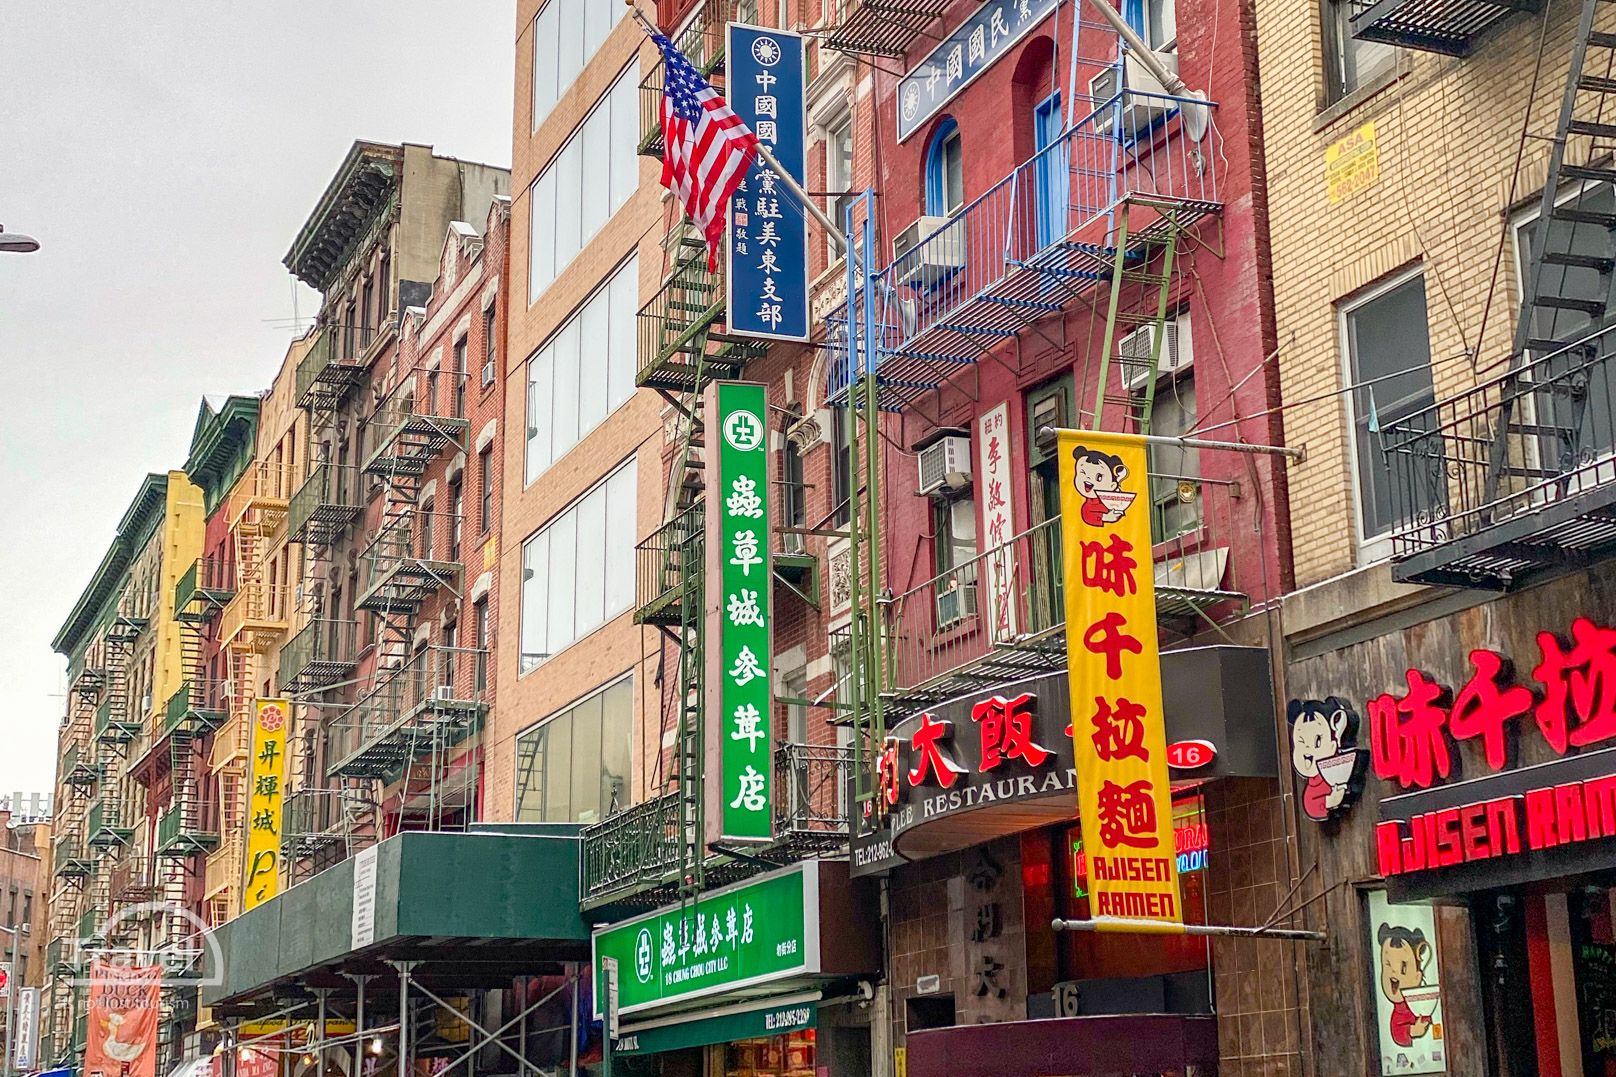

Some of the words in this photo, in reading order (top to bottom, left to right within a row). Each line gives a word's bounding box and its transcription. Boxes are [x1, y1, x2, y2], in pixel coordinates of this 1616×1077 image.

[1338, 133, 1364, 156] ASA
[726, 475, 767, 811] 蟲草城參茸店
[1080, 533, 1160, 849] 味千拉麵
[1366, 617, 1616, 789] 味千拉
[1172, 747, 1201, 764] 16
[863, 800, 873, 812] 16
[1376, 796, 1521, 877] AJISEN
[1093, 857, 1171, 882] AJISEN
[1098, 891, 1175, 917] RAMEN
[665, 972, 673, 985] 18
[673, 967, 690, 983] CHUNG
[690, 963, 705, 978] CHOU
[705, 959, 717, 974] CITY
[717, 956, 729, 970] LLC
[1052, 984, 1079, 1017] 16
